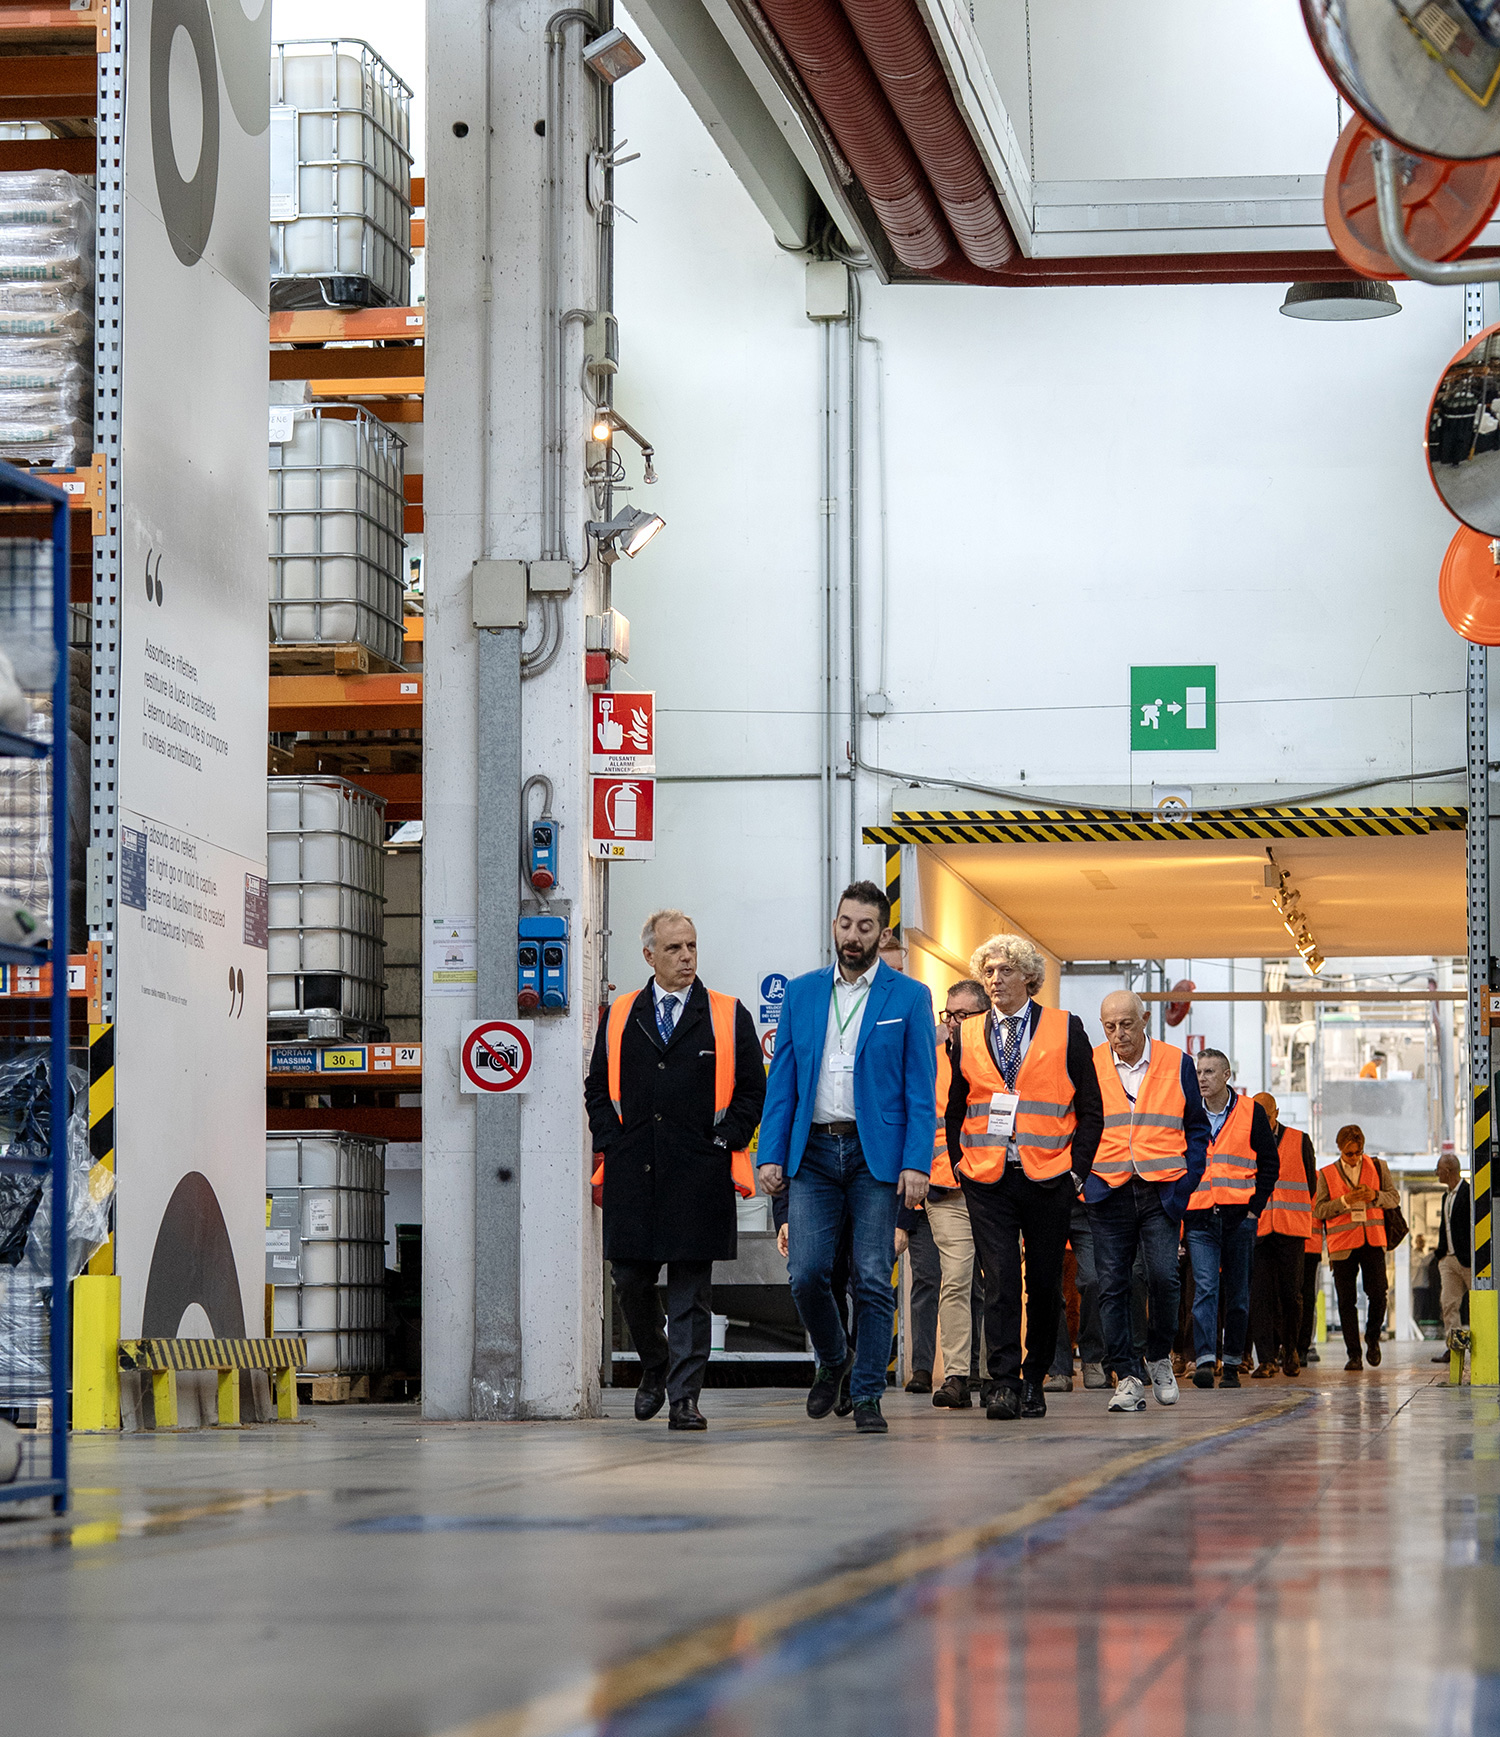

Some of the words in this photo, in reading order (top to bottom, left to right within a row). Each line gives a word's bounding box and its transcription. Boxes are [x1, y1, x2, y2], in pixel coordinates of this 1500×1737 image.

[613, 846, 624, 855] 32
[1494, 1000, 1499, 1009] 2
[401, 1049, 414, 1060] 2V
[332, 1055, 346, 1065] 30
